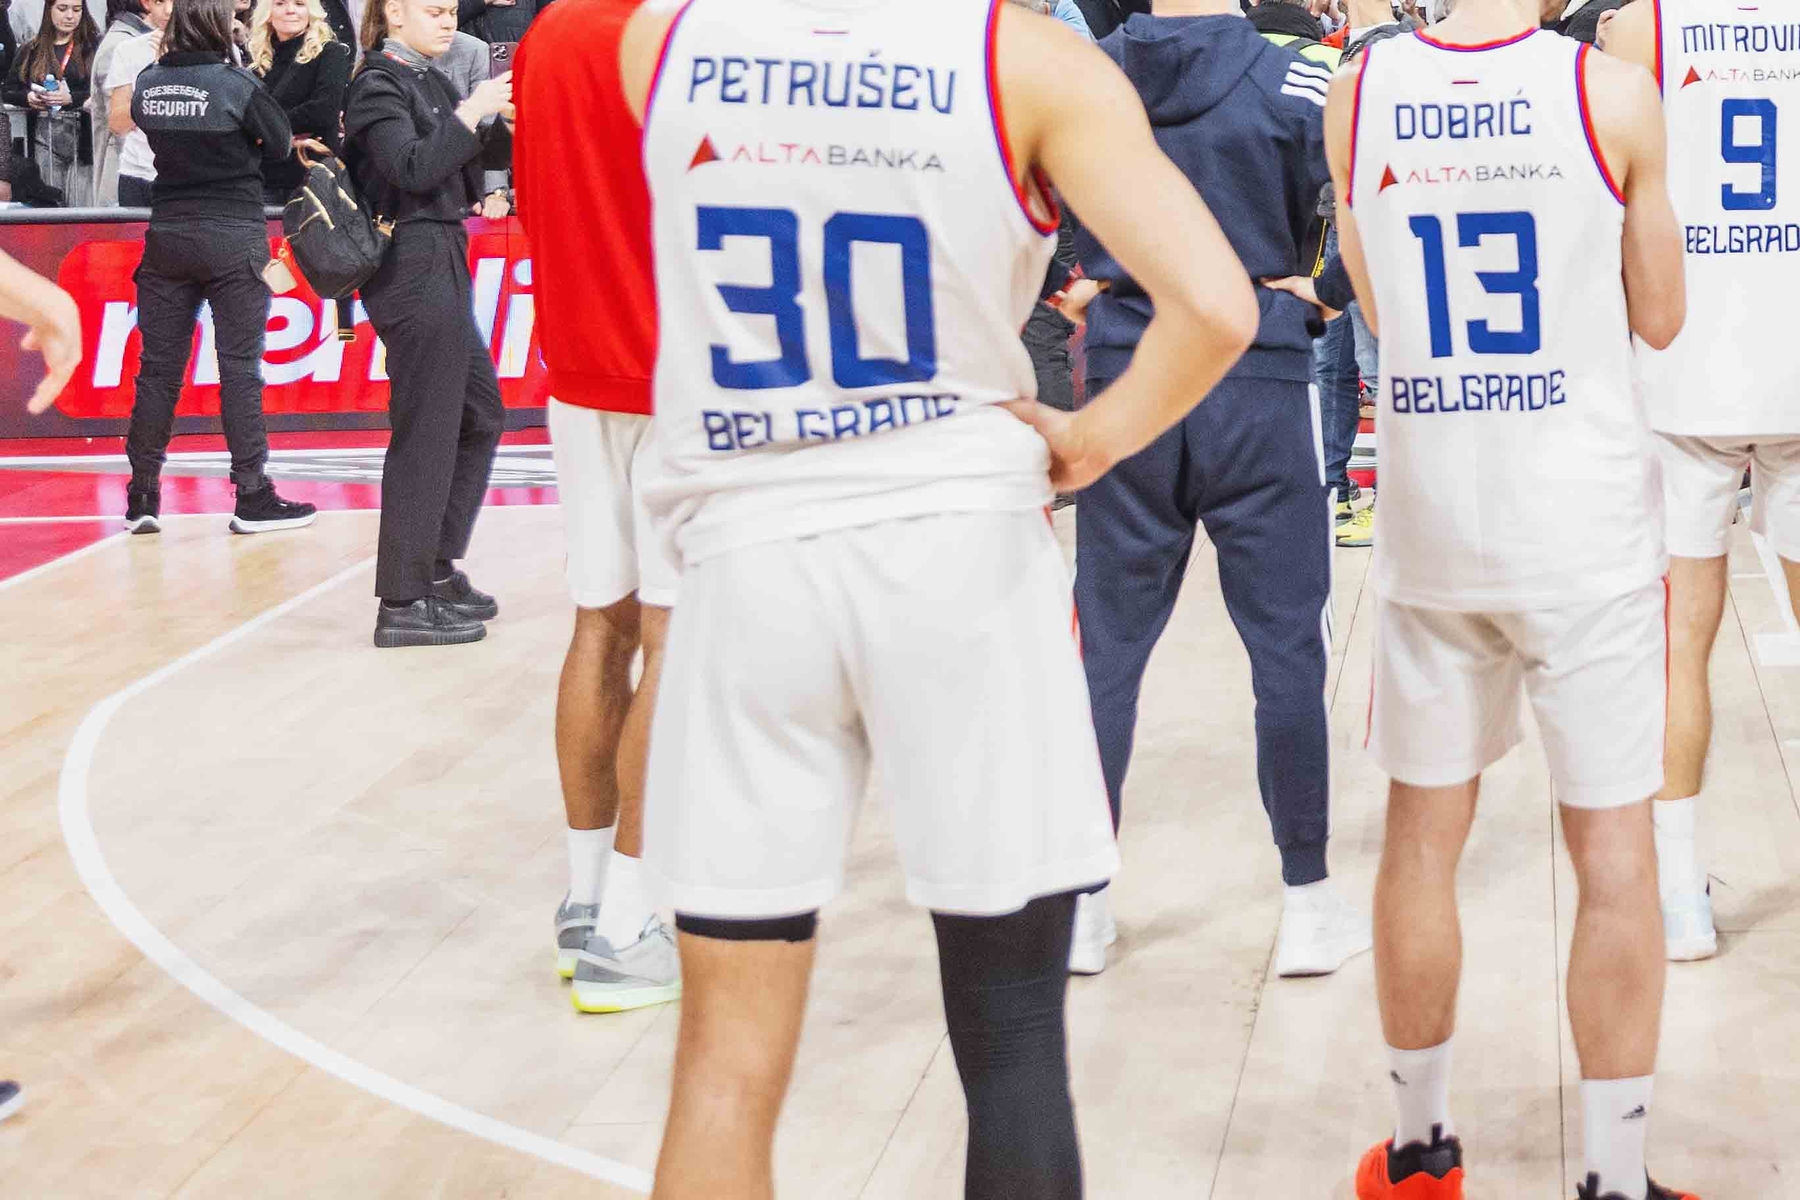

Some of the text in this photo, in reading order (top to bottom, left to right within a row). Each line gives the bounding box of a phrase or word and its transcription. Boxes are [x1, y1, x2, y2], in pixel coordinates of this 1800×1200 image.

[142, 100, 210, 117] SECURITY
[688, 50, 957, 116] PETRUŠEV
[1395, 89, 1532, 141] DOBRIĆ
[730, 143, 946, 173] ALTABANKA
[1406, 163, 1565, 185] ALTABANKA
[1721, 97, 1778, 211] 9
[696, 206, 938, 389] 30
[1408, 210, 1541, 359] 13
[1391, 369, 1567, 415] BELGRADE
